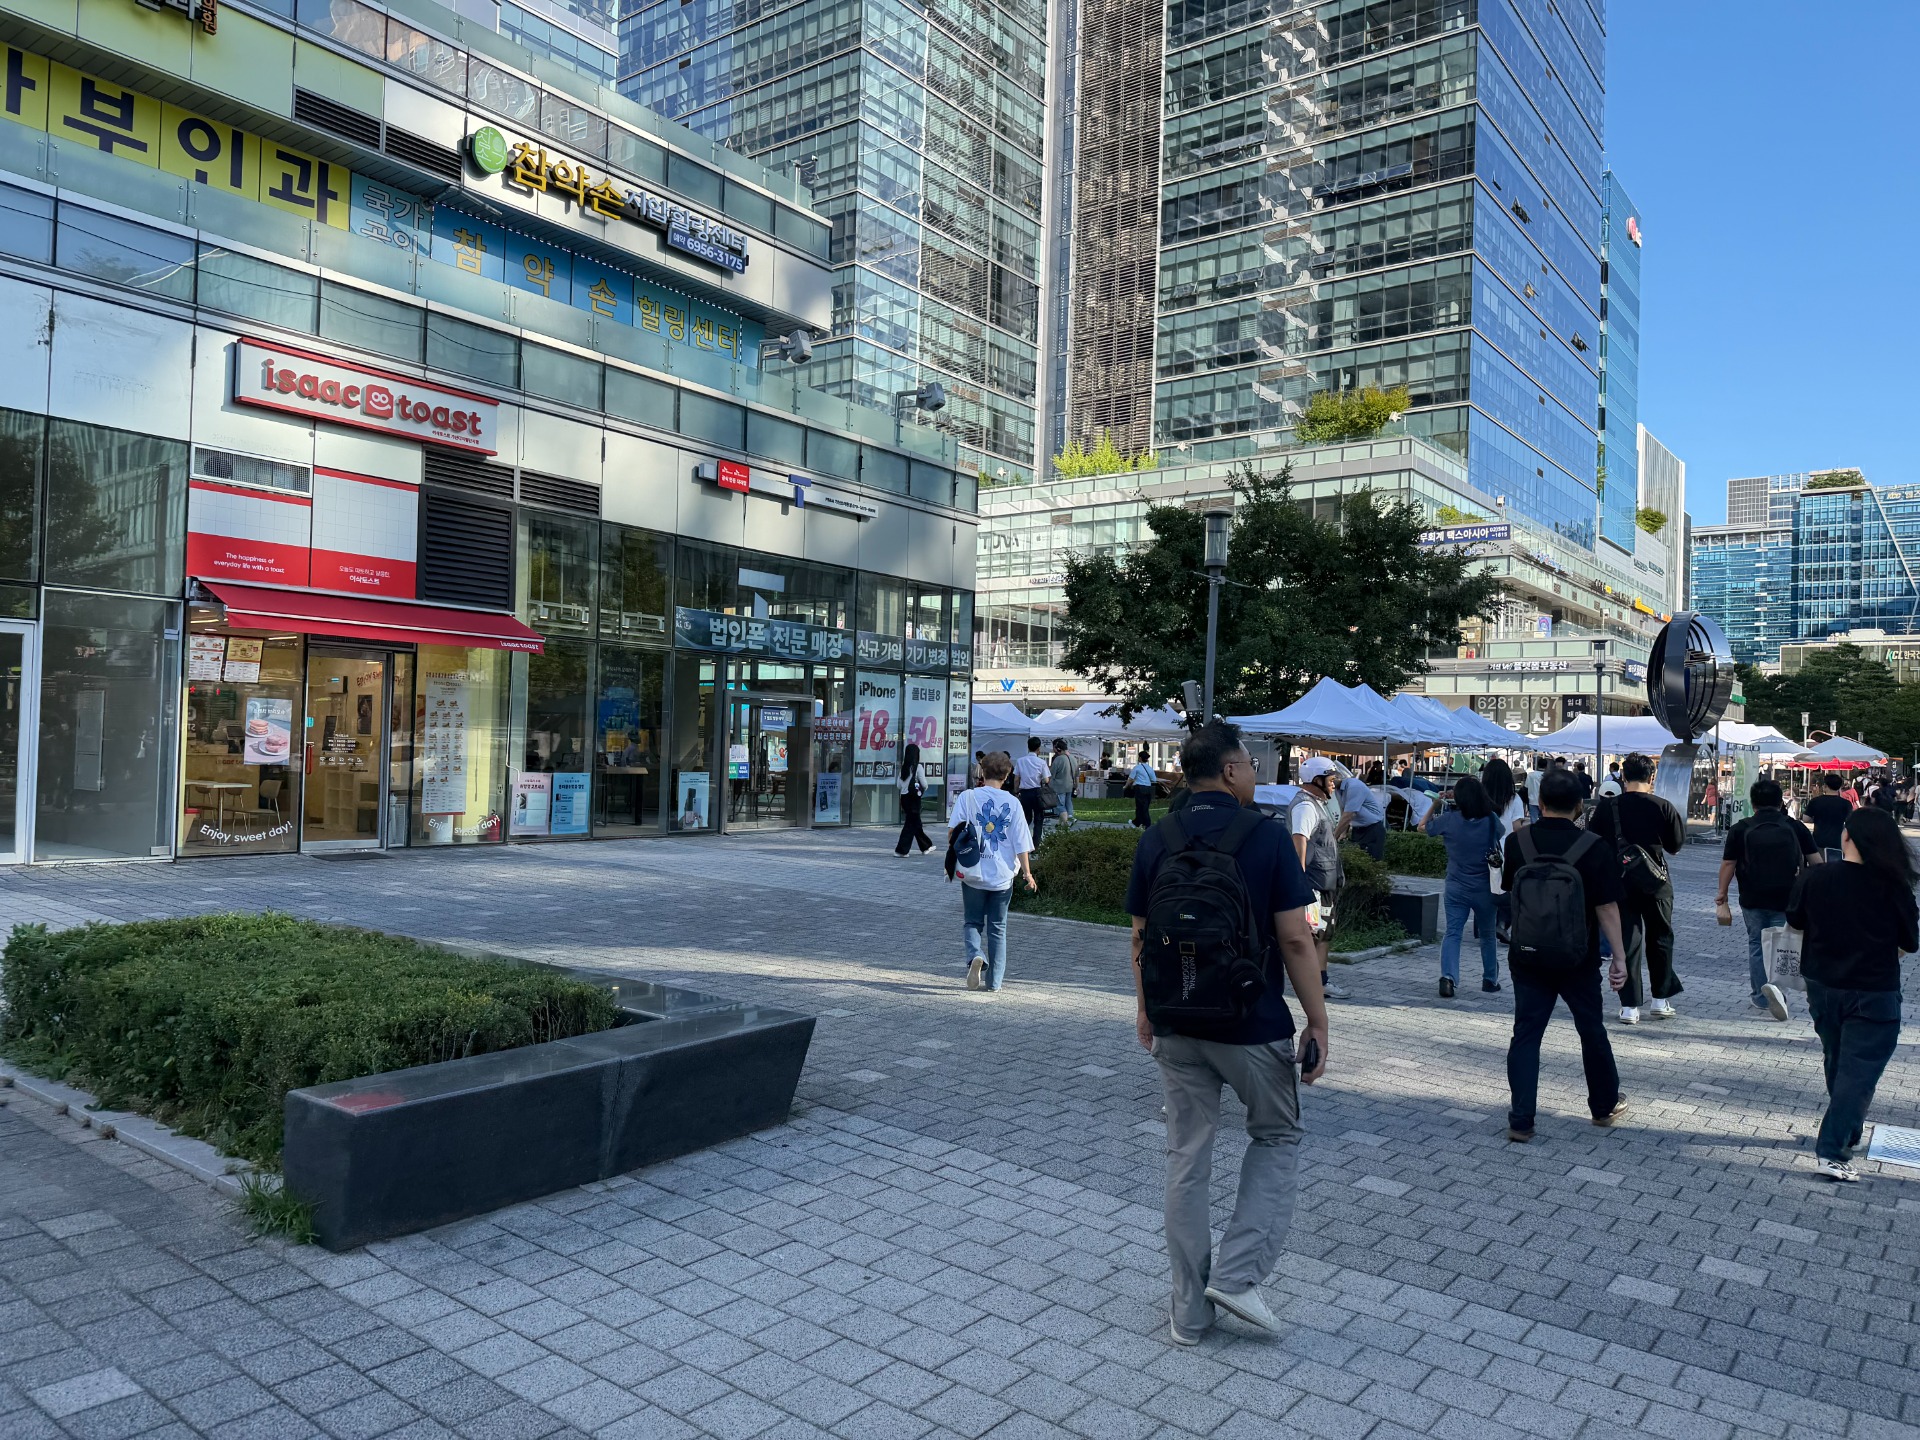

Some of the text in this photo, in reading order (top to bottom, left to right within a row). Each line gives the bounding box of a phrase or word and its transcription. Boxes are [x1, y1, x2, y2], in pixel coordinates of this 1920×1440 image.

[511, 142, 624, 220] 참약손
[363, 186, 424, 231] 국가
[687, 239, 743, 270] 6956-3175
[637, 295, 738, 359] 힐링센터
[263, 358, 483, 436] isaac toast
[213, 560, 242, 569] everyday
[242, 562, 251, 570] life
[225, 552, 237, 560] The
[238, 554, 267, 564] happiness
[709, 617, 844, 659] 법인폰 전문 매장
[857, 638, 969, 667] 신규 가입 기기 변경 법인
[859, 680, 896, 699] iPhone
[1477, 696, 1560, 710] 6281 6797
[859, 709, 890, 751] 18
[907, 716, 937, 748] 50
[200, 820, 293, 843] Enjoy sweet day!
[1181, 955, 1190, 1001] GEOGRAPHIC
